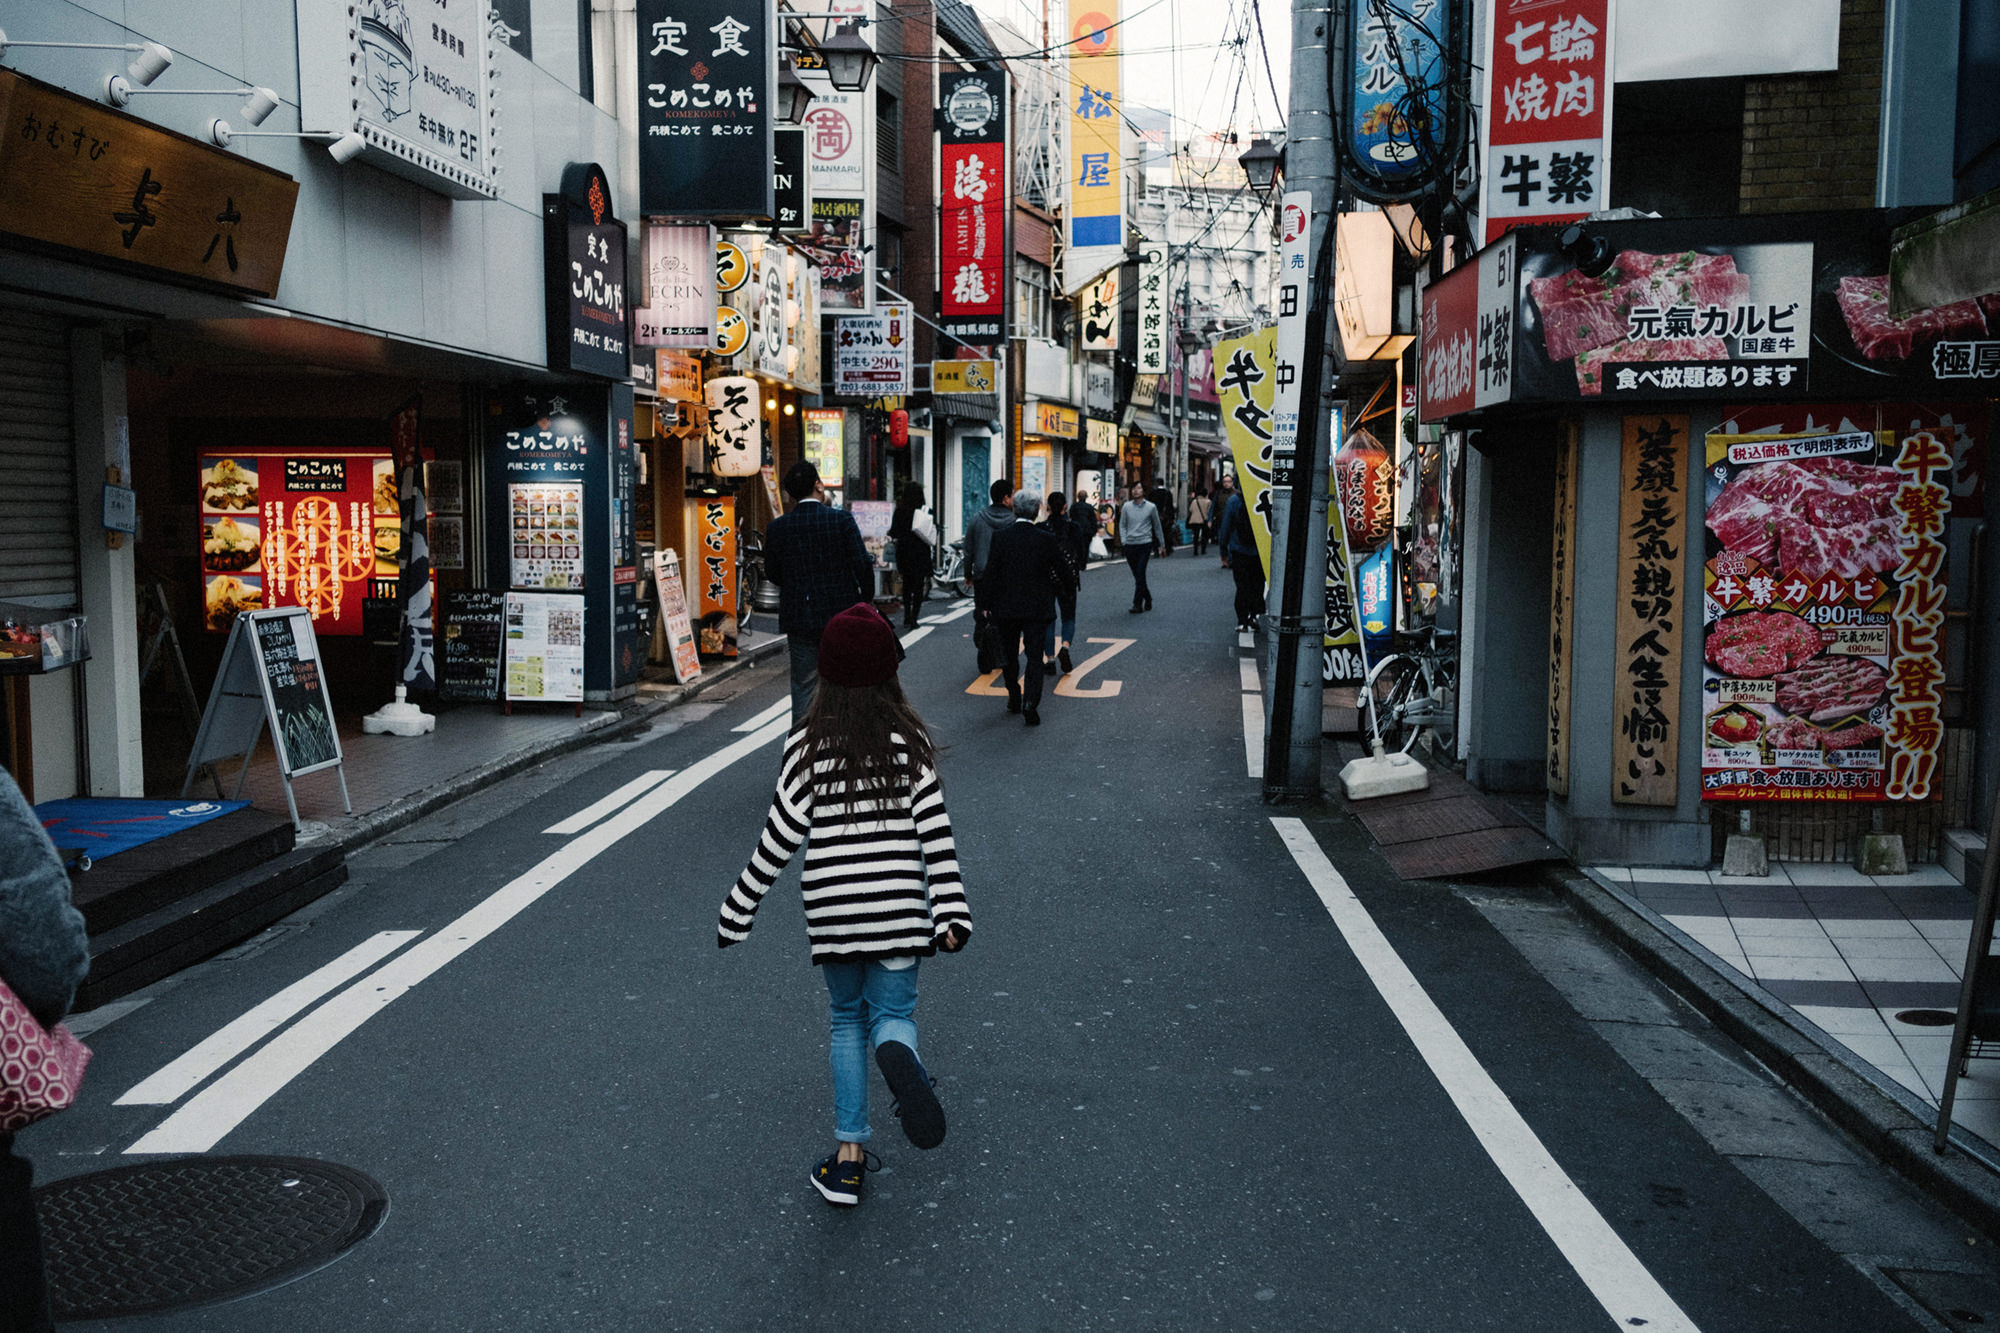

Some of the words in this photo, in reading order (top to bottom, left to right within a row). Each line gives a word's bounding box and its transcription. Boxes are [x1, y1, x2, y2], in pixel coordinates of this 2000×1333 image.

[432, 23, 465, 58] 営業時間
[651, 16, 750, 57] 定食
[1505, 14, 1598, 65] 七輪
[648, 83, 754, 108] こめこめや
[1504, 70, 1595, 124] 焼肉
[665, 110, 736, 118] KOMEKOMEYA
[21, 115, 110, 160] おむすび
[418, 113, 455, 148] 年中無休
[460, 130, 477, 161] 2F
[1076, 85, 1112, 187] 松屋
[812, 165, 861, 174] MANMARU
[1500, 152, 1594, 206] 牛繁
[780, 208, 797, 221] 2F
[588, 234, 608, 263] 定食
[1498, 245, 1512, 287] B1
[572, 261, 622, 313] こめこめや
[651, 286, 703, 299] ECRIN
[642, 324, 659, 337] 2F
[1629, 303, 1799, 340] 元氣カルビ
[1479, 306, 1511, 391] 牛繁
[1741, 338, 1796, 354] 国産牛
[1425, 328, 1473, 403] 七輪焼肉
[1616, 365, 1797, 390] 食べ放題あります
[724, 385, 755, 450] そば
[506, 432, 585, 451] こめこめや
[1733, 435, 1870, 461] 税込価格で明朗表示!
[288, 461, 342, 476] こめこめや
[705, 503, 729, 550] そば
[707, 556, 729, 606] 天丼
[1717, 562, 1747, 575] 逸品
[1713, 576, 1877, 604] 牛繁カルビ
[1839, 631, 1884, 643] 元氣カルビ
[1722, 681, 1774, 693] 中落ちカルビ
[1704, 769, 1750, 790] 大好評
[1752, 769, 1879, 788] 食べ放題あります!
